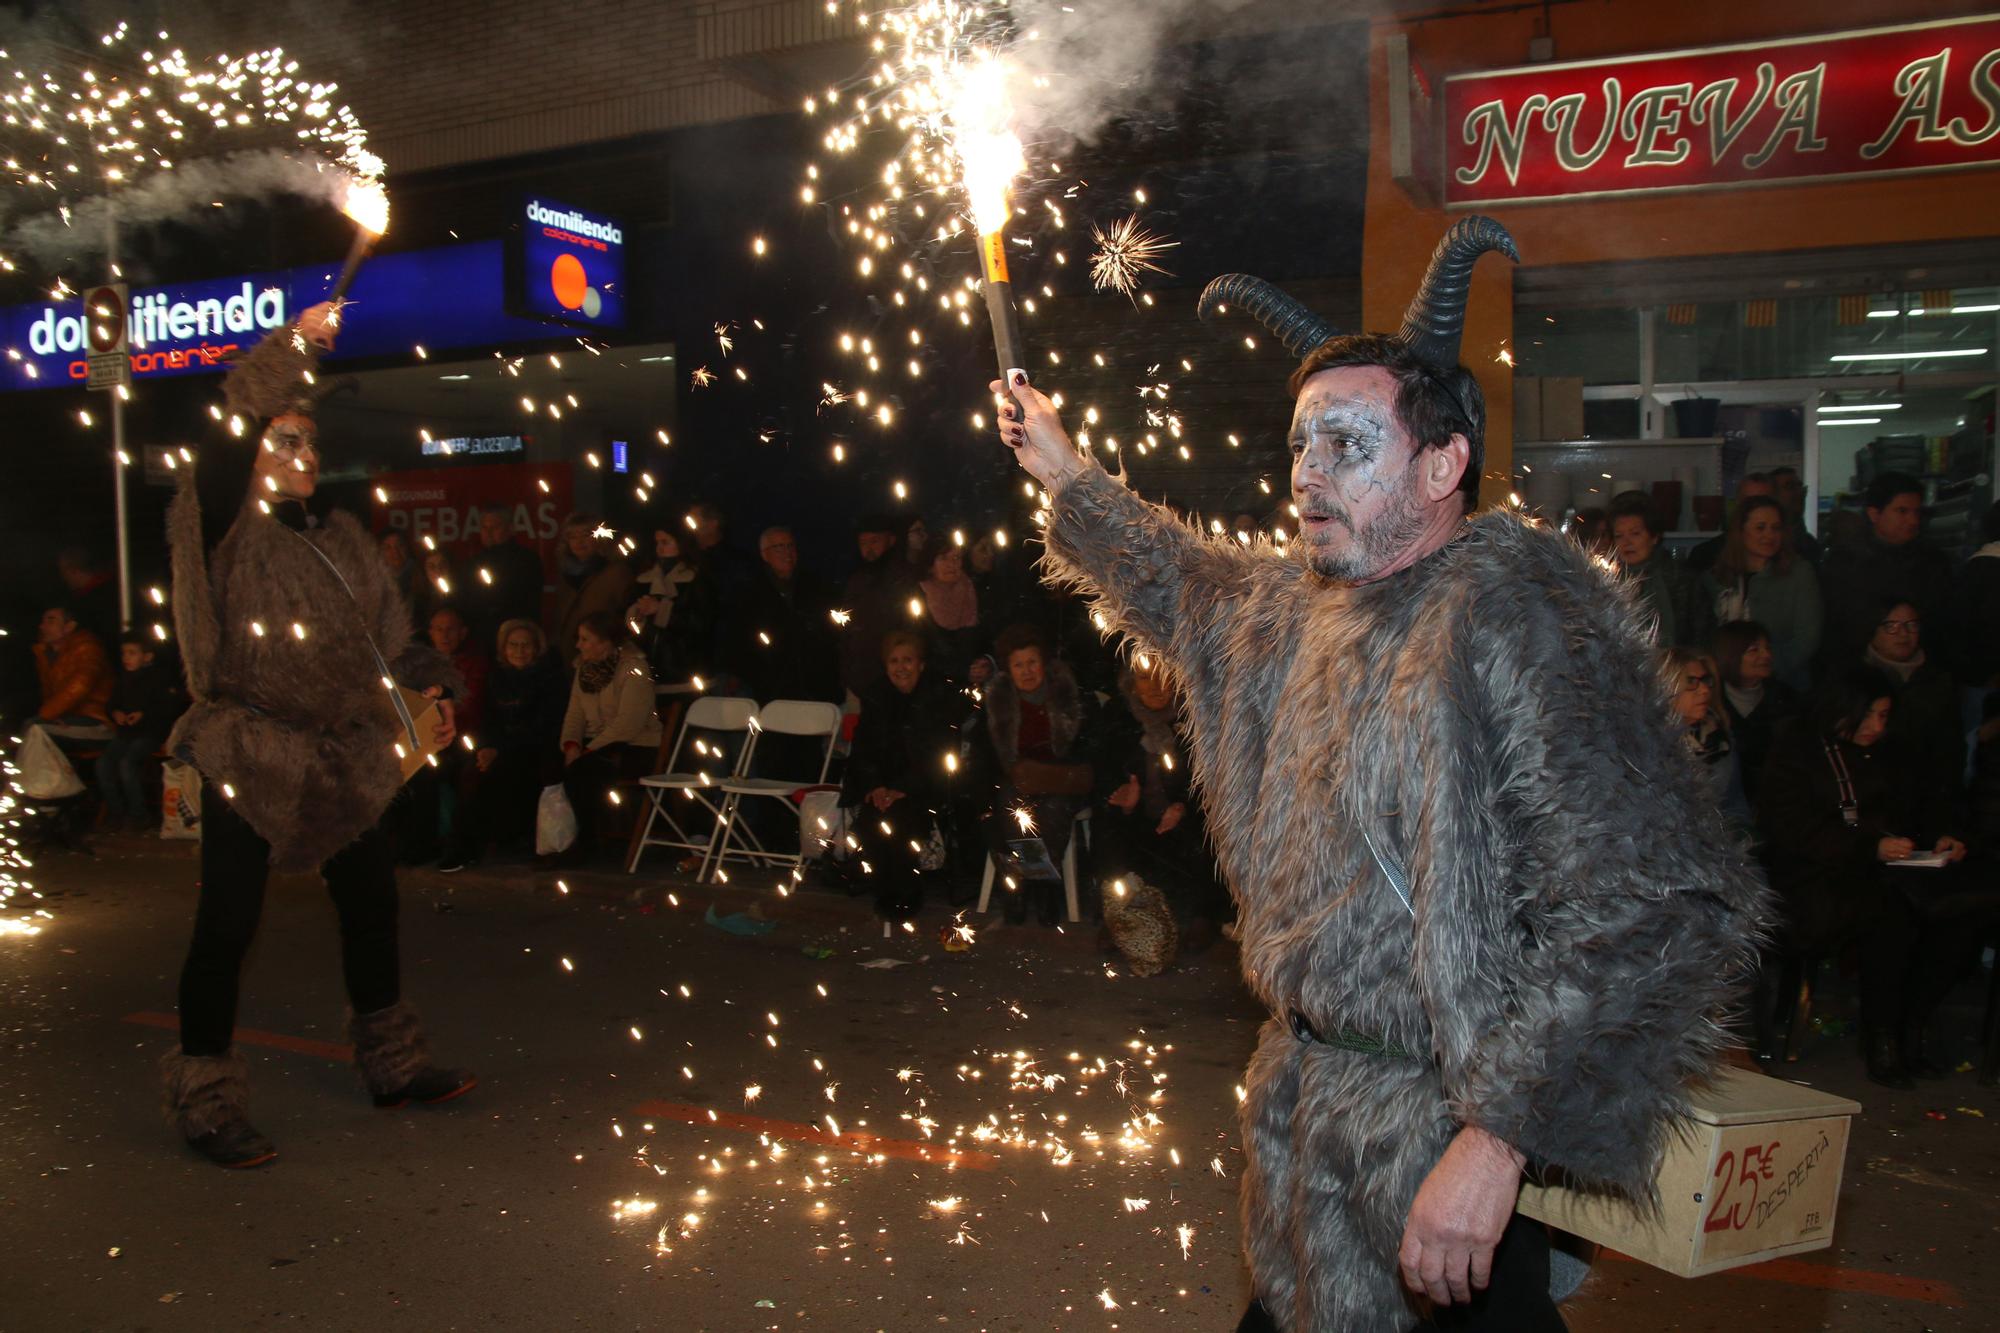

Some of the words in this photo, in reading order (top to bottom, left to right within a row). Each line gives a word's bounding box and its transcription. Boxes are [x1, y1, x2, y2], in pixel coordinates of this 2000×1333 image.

[1455, 62, 1827, 187] NUEVA
[1860, 46, 2000, 160] AS
[526, 200, 622, 244] dormitienda
[29, 282, 285, 355] doitienda
[389, 502, 560, 543] REBAAS
[1704, 1141, 1781, 1233] 25€
